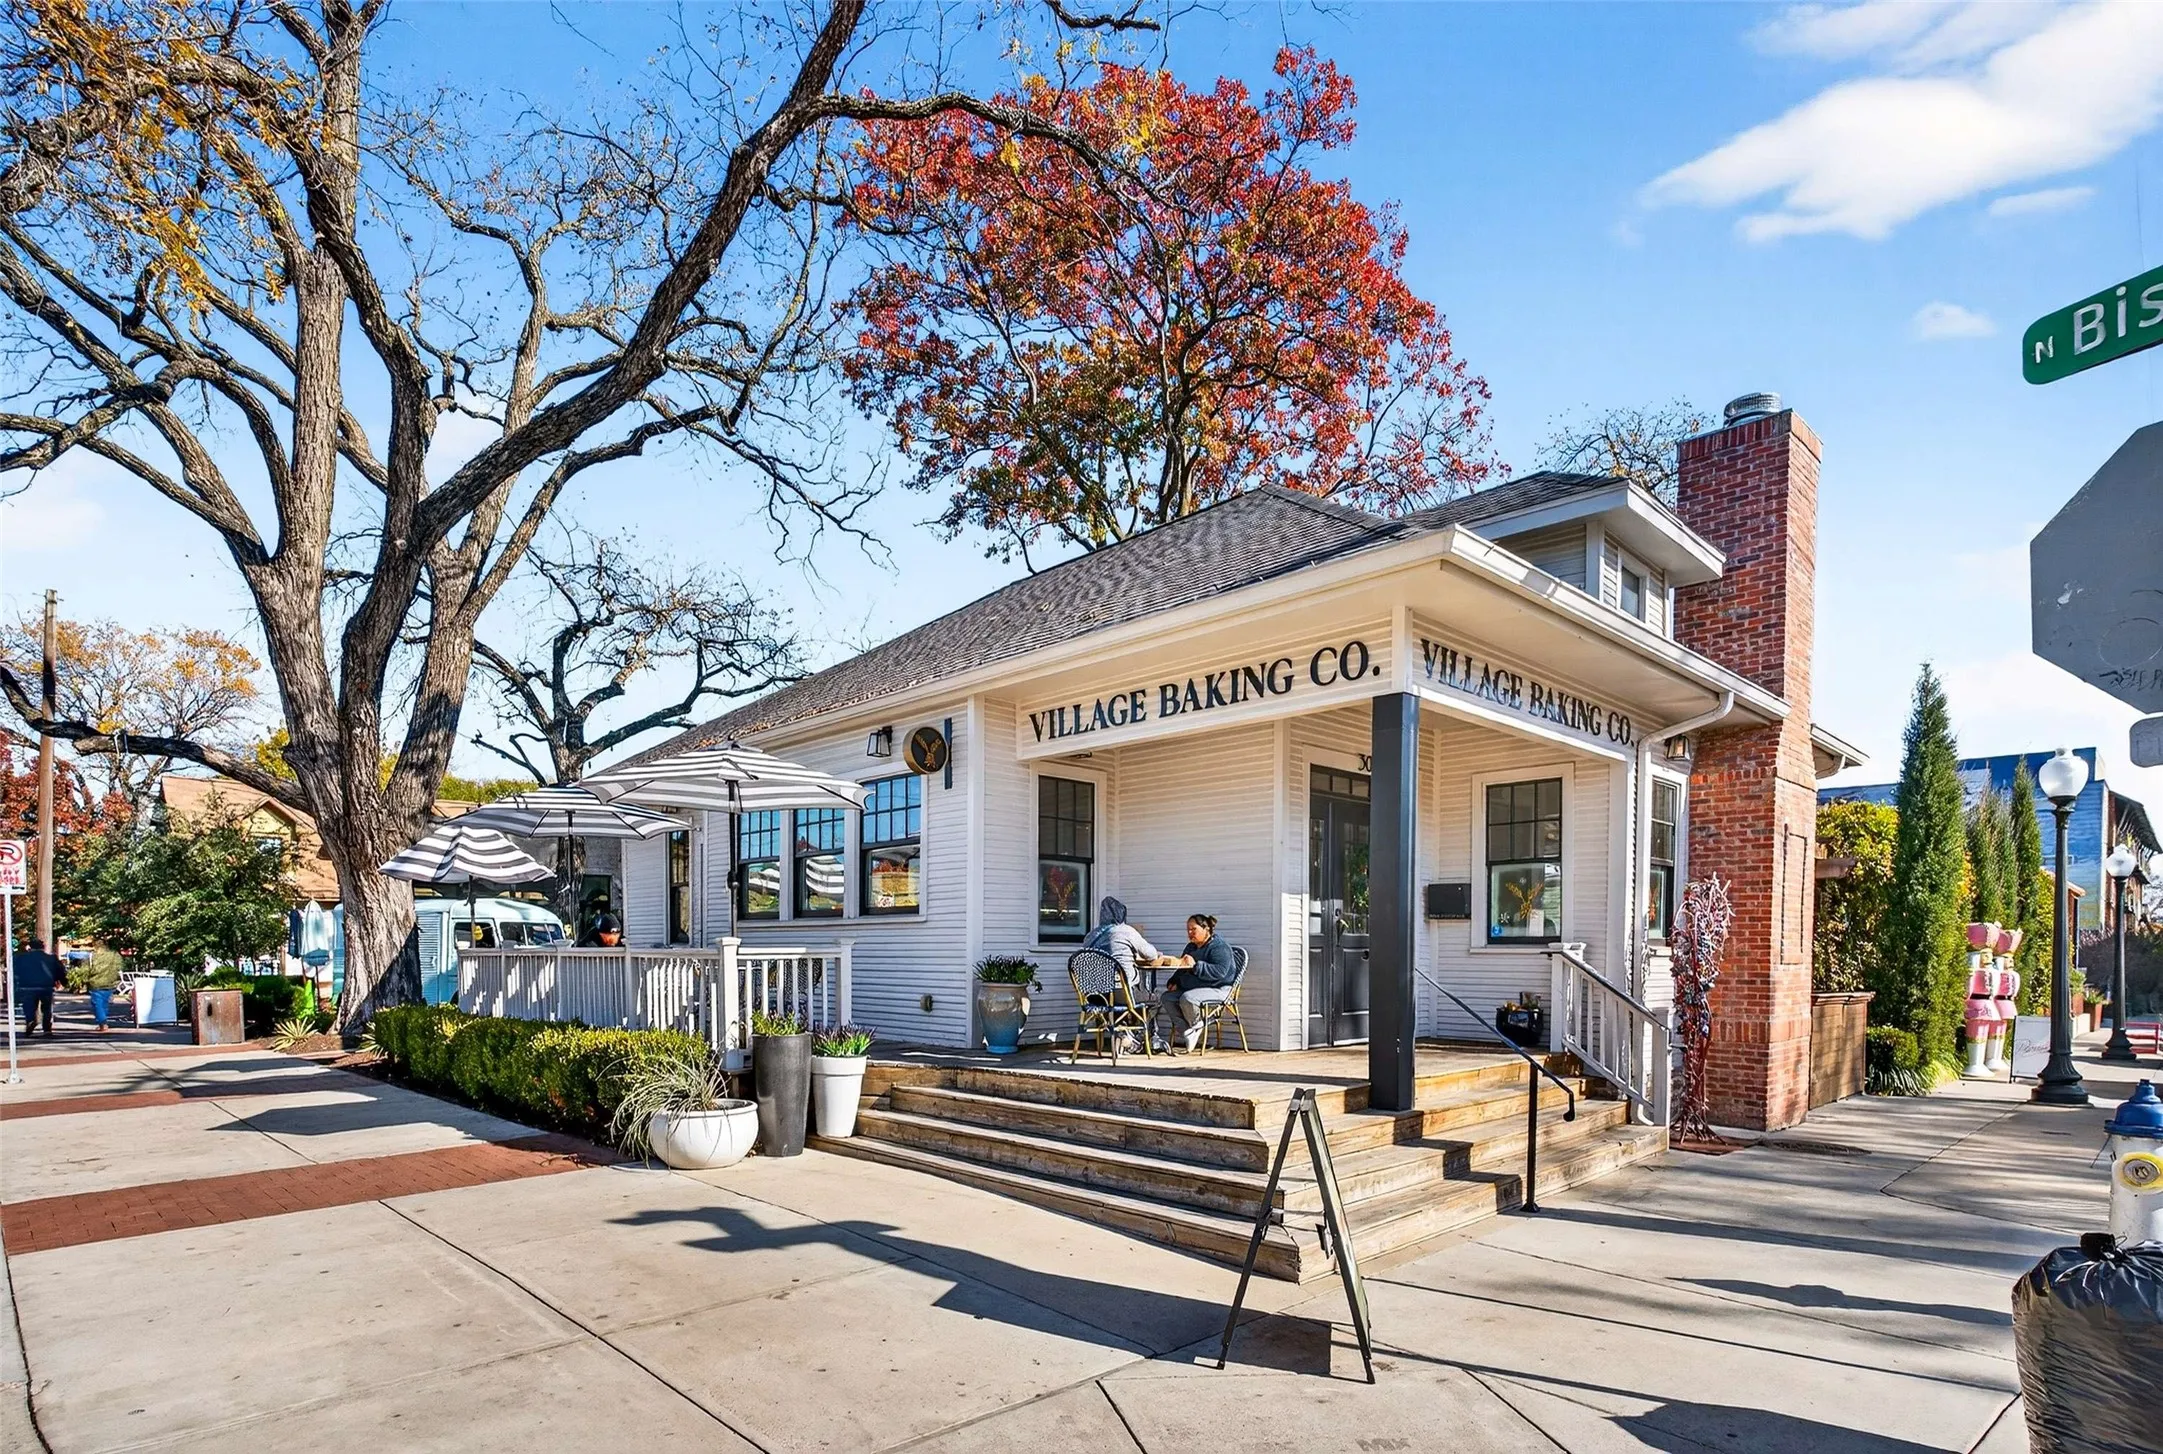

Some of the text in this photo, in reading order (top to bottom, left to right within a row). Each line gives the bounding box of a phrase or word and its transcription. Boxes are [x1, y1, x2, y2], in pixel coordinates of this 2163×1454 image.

[2034, 335, 2054, 363] N
[1028, 640, 1381, 742] VILLAGE BAKING CO.
[1420, 637, 1635, 748] VILLAGE BAKING CO.
